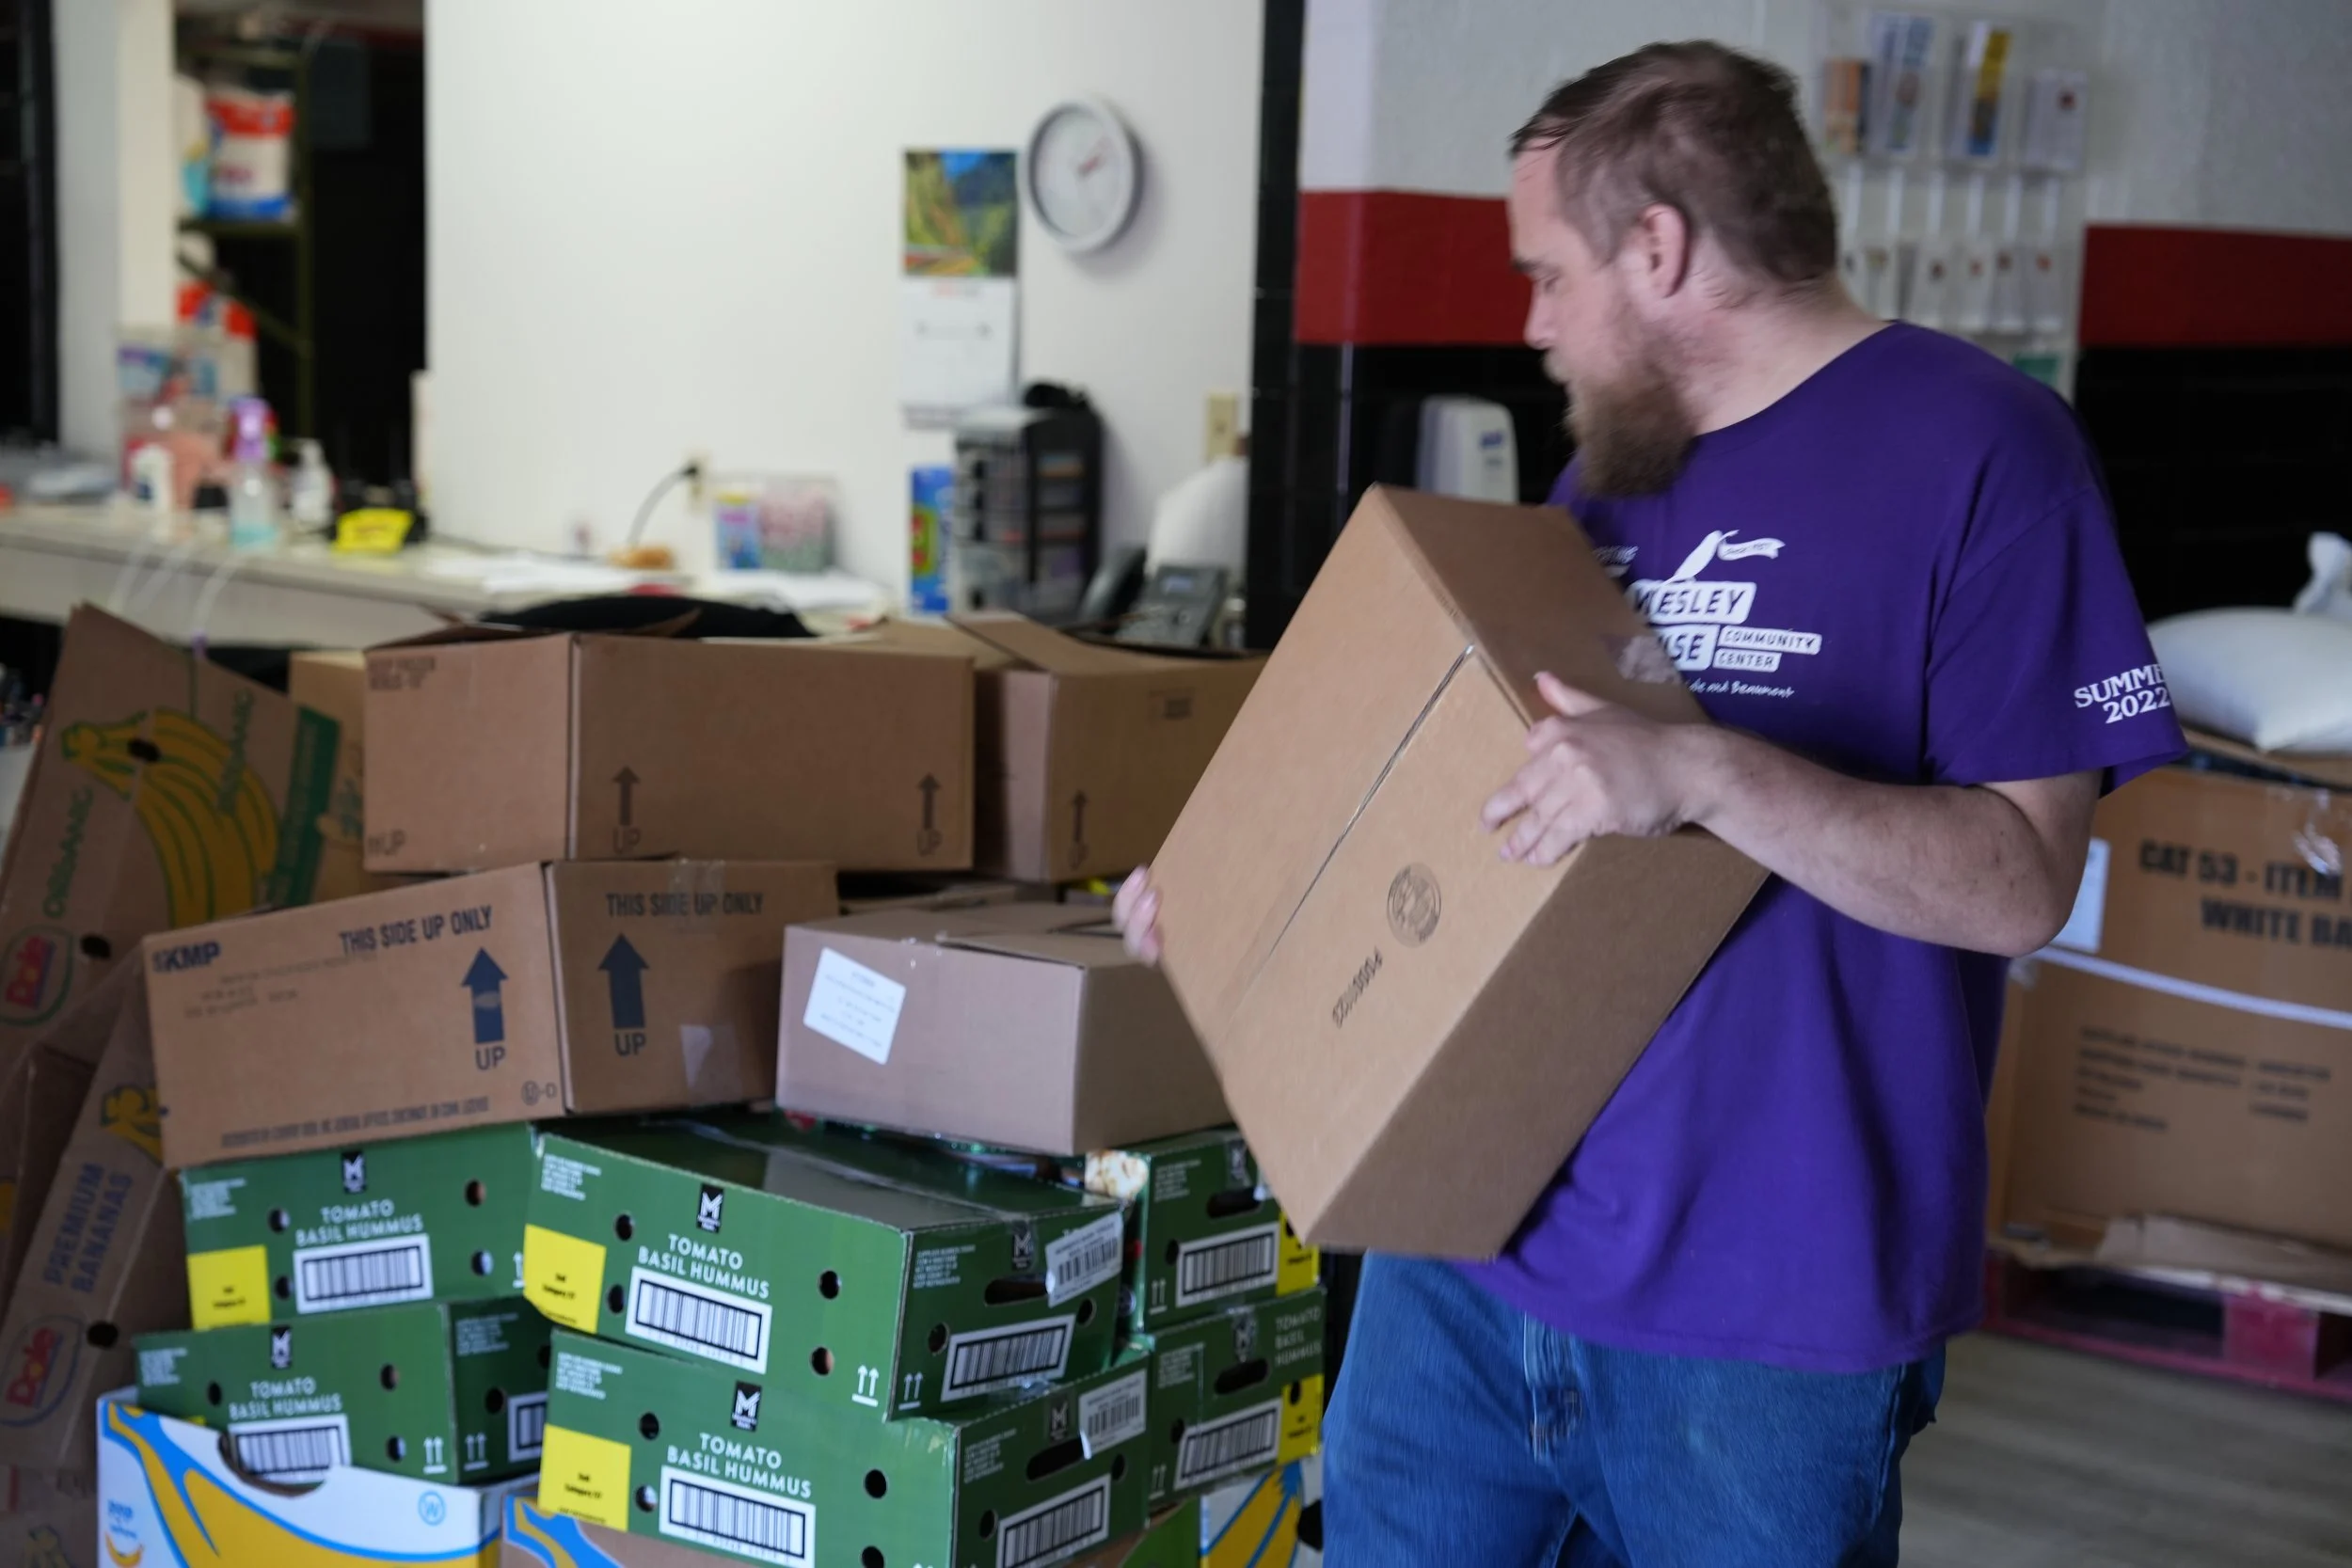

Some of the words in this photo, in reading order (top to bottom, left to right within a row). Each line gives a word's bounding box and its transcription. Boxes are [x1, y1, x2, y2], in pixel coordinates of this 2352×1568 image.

[1634, 587, 1745, 615] WESLEY
[1658, 632, 1708, 661] USE
[1724, 629, 1816, 649] COMMUNITY
[1719, 652, 1774, 669] CENTER
[2074, 663, 2165, 708] SUMME
[2103, 687, 2171, 723] 2022
[2138, 837, 2191, 878] CAT
[2199, 850, 2238, 886] 53
[606, 893, 645, 917] THIS
[650, 893, 689, 917] SIDE
[694, 892, 718, 916] UP
[723, 891, 764, 915] ONLY
[2201, 896, 2300, 944] WHITE
[339, 929, 376, 956] THIS
[380, 920, 417, 949] SIDE
[422, 914, 445, 940] UP
[452, 905, 493, 935] ONLY
[476, 1045, 506, 1070] UP
[614, 1032, 646, 1057] UP
[42, 1162, 104, 1287] PREMIUM
[294, 1225, 344, 1246] BASIL
[346, 1213, 423, 1242] HUMMUS
[320, 1199, 395, 1224] TOMATO
[71, 1171, 134, 1293] BANANAS
[668, 1233, 743, 1270] TOMATO
[638, 1245, 687, 1276] BASIL
[690, 1260, 770, 1299] HUMMUS
[6, 1327, 56, 1408] Dole
[229, 1401, 270, 1419] BASIL
[272, 1393, 342, 1416] HUMMUS
[249, 1376, 316, 1400] TOMATO
[699, 1433, 783, 1469] TOMATO
[667, 1445, 721, 1476] BASIL
[724, 1461, 812, 1499] HUMMUS
